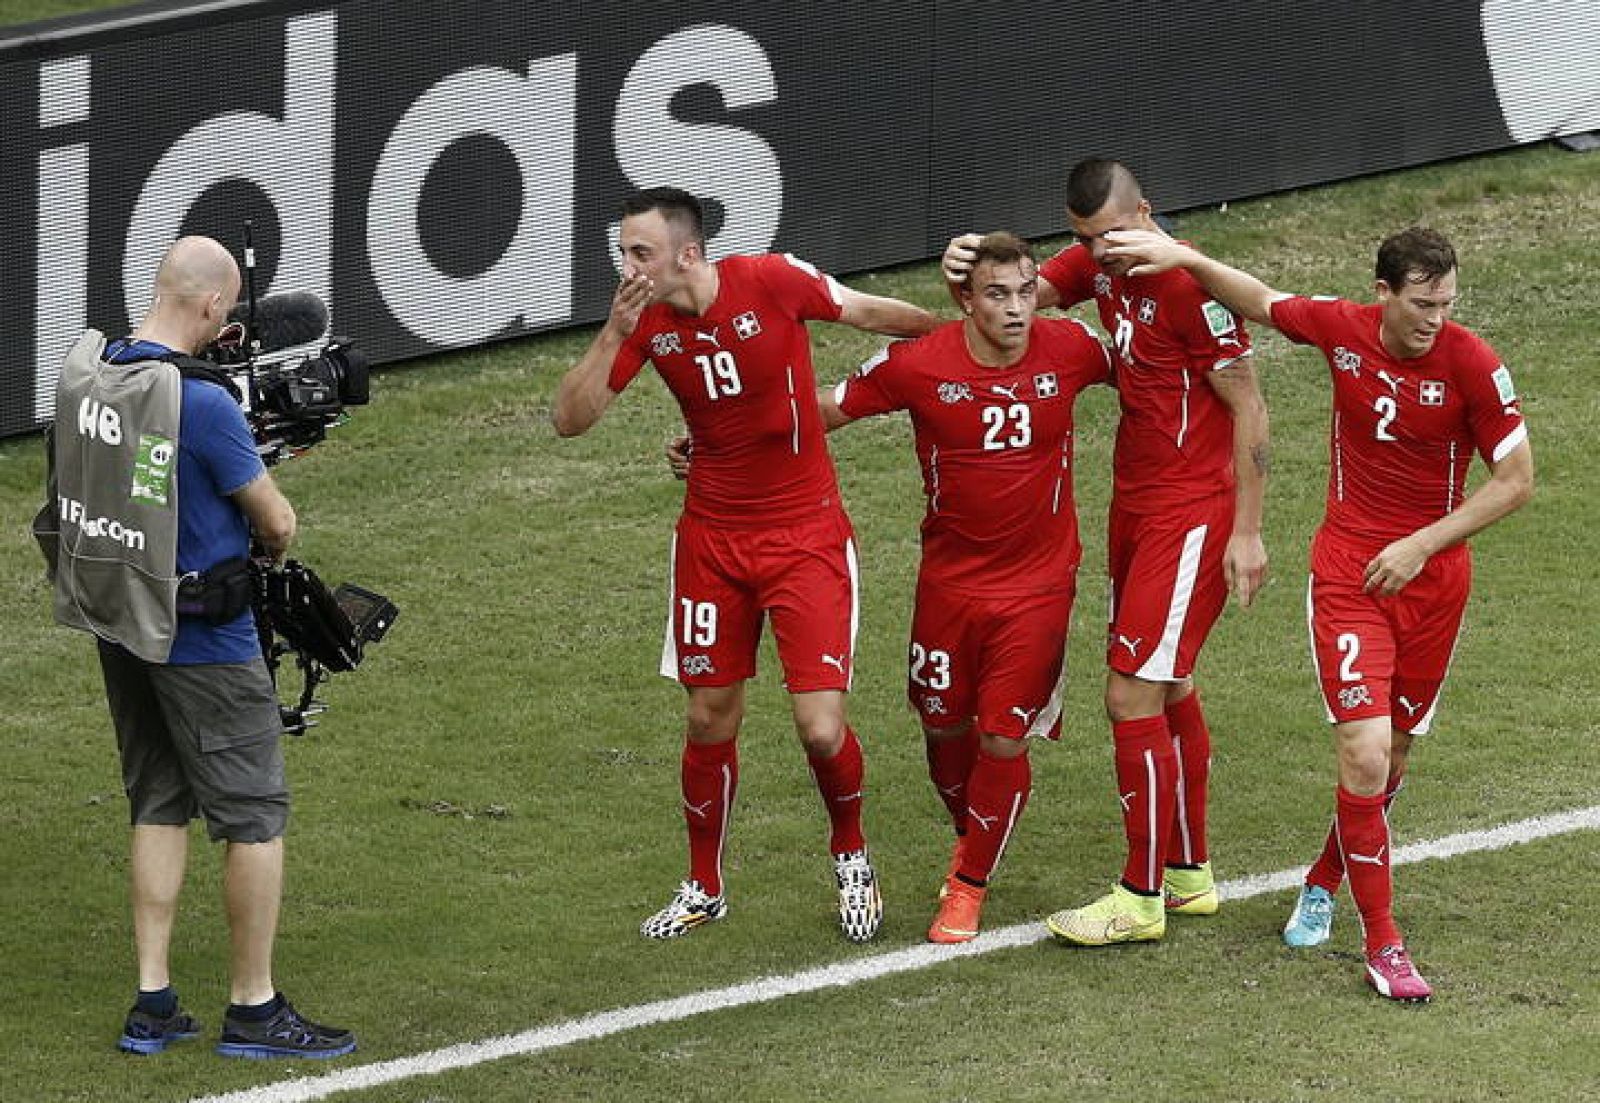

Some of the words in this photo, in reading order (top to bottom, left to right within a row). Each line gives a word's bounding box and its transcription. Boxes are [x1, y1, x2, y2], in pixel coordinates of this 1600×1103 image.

[34, 10, 783, 422] idas
[694, 350, 743, 400] 19
[79, 397, 122, 446] HB
[982, 403, 1032, 450] 23
[1374, 395, 1398, 441] 2
[681, 597, 717, 648] 19
[911, 642, 951, 690] 23
[1337, 633, 1363, 681] 2
